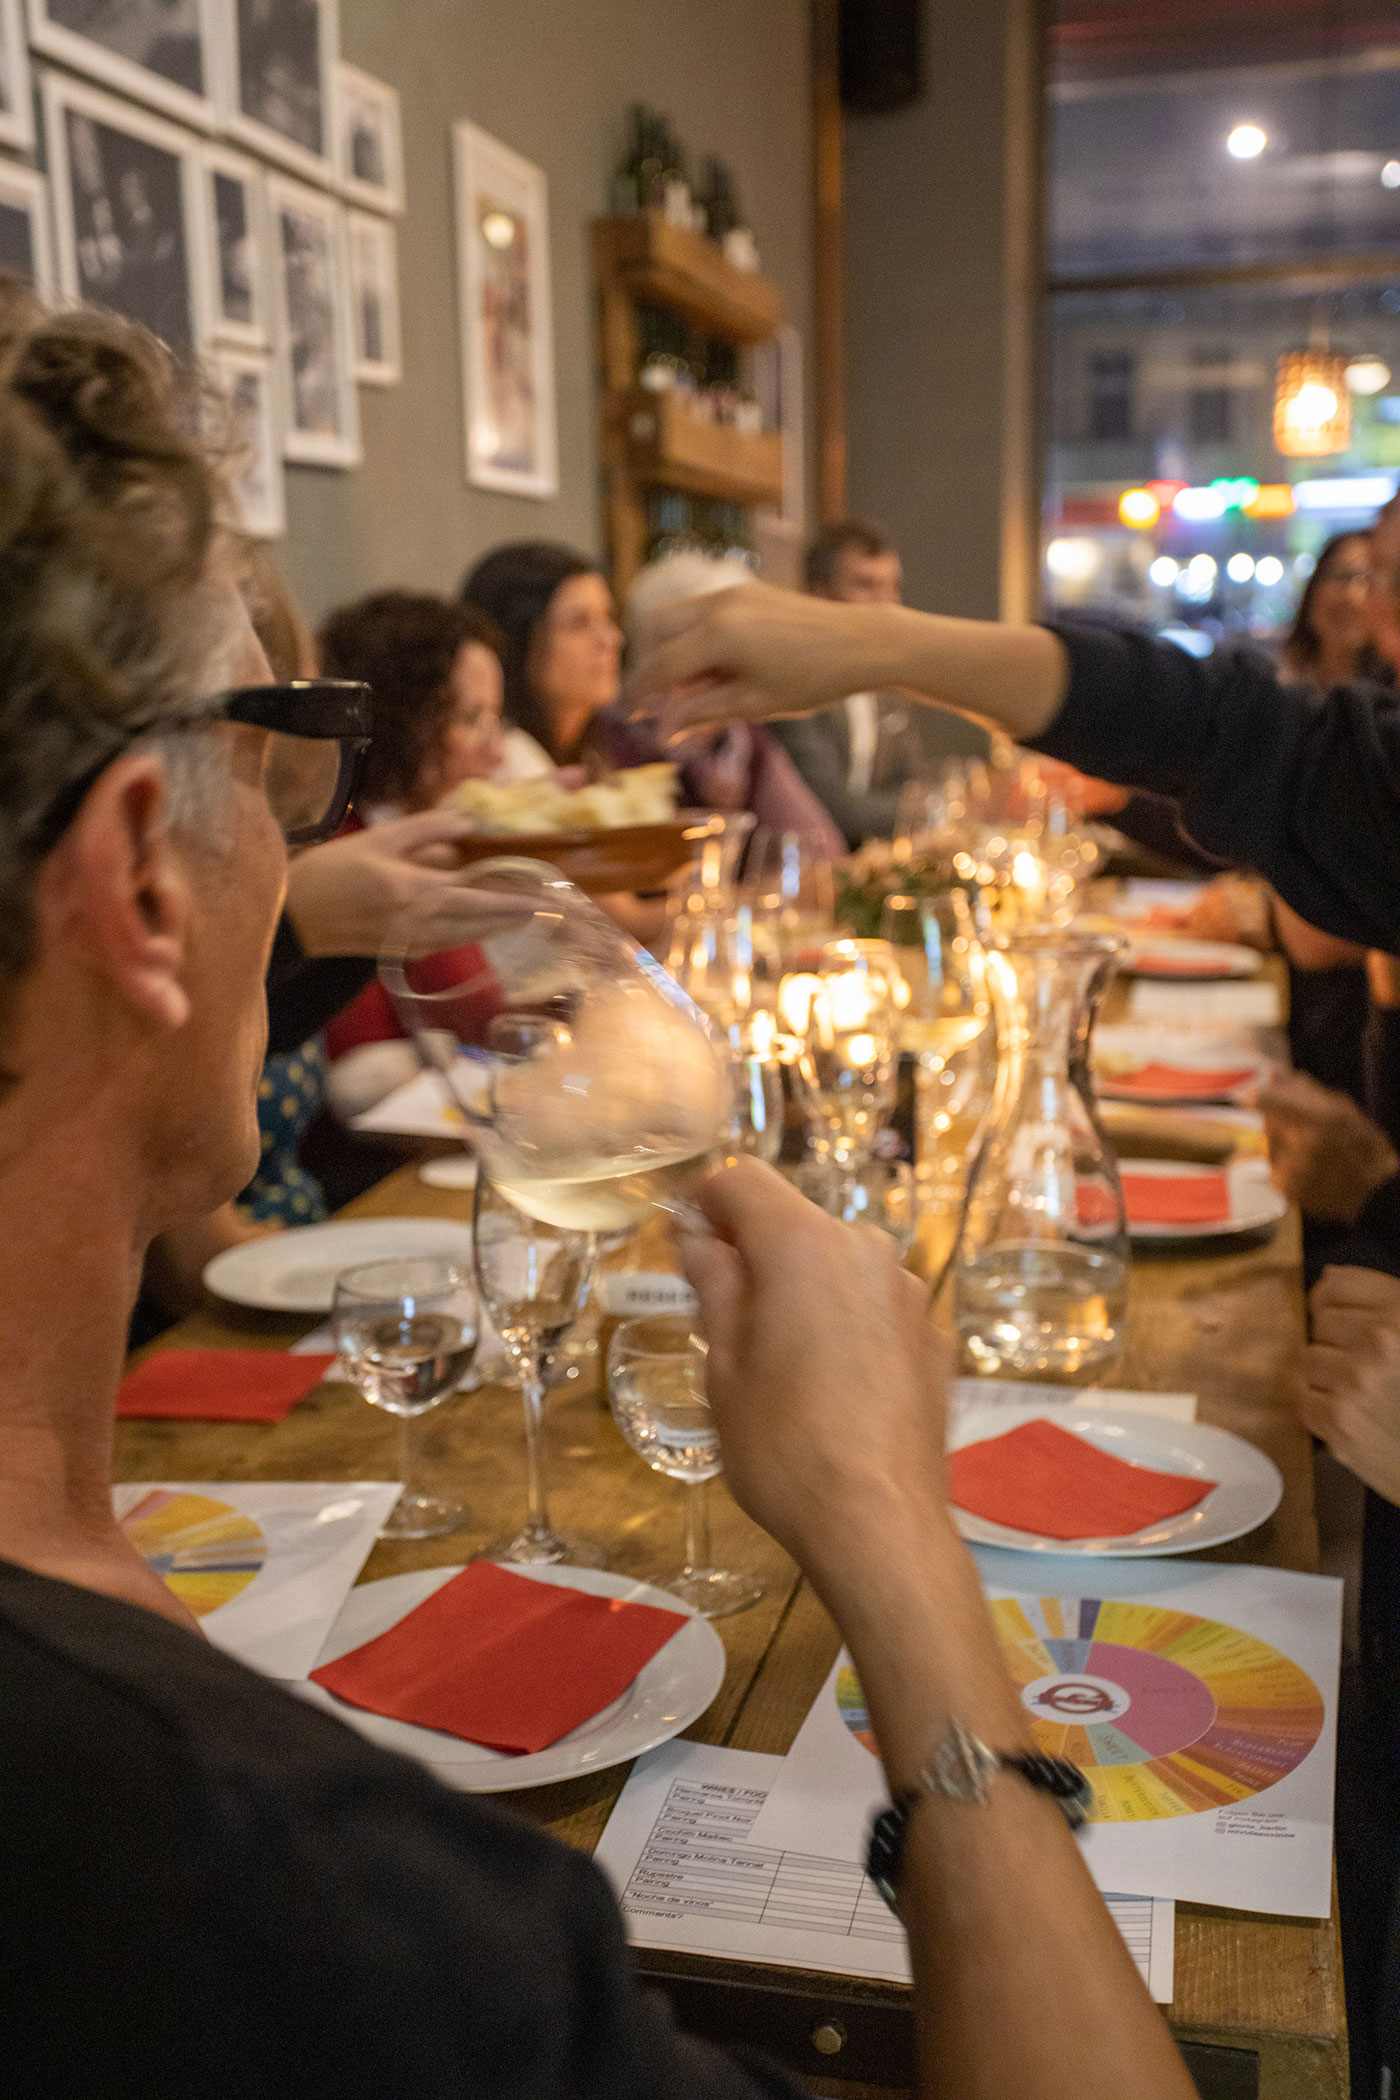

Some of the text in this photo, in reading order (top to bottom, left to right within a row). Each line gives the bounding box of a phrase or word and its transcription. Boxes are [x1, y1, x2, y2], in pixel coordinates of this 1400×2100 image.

[702, 1783, 734, 1794] WINES
[672, 1792, 705, 1805] Pairing
[664, 1813, 697, 1825] Pairing
[655, 1833, 688, 1845] Pairing
[645, 1855, 679, 1866] Pairing
[635, 1876, 670, 1888] Pairing
[622, 1906, 683, 1919] Comments?
